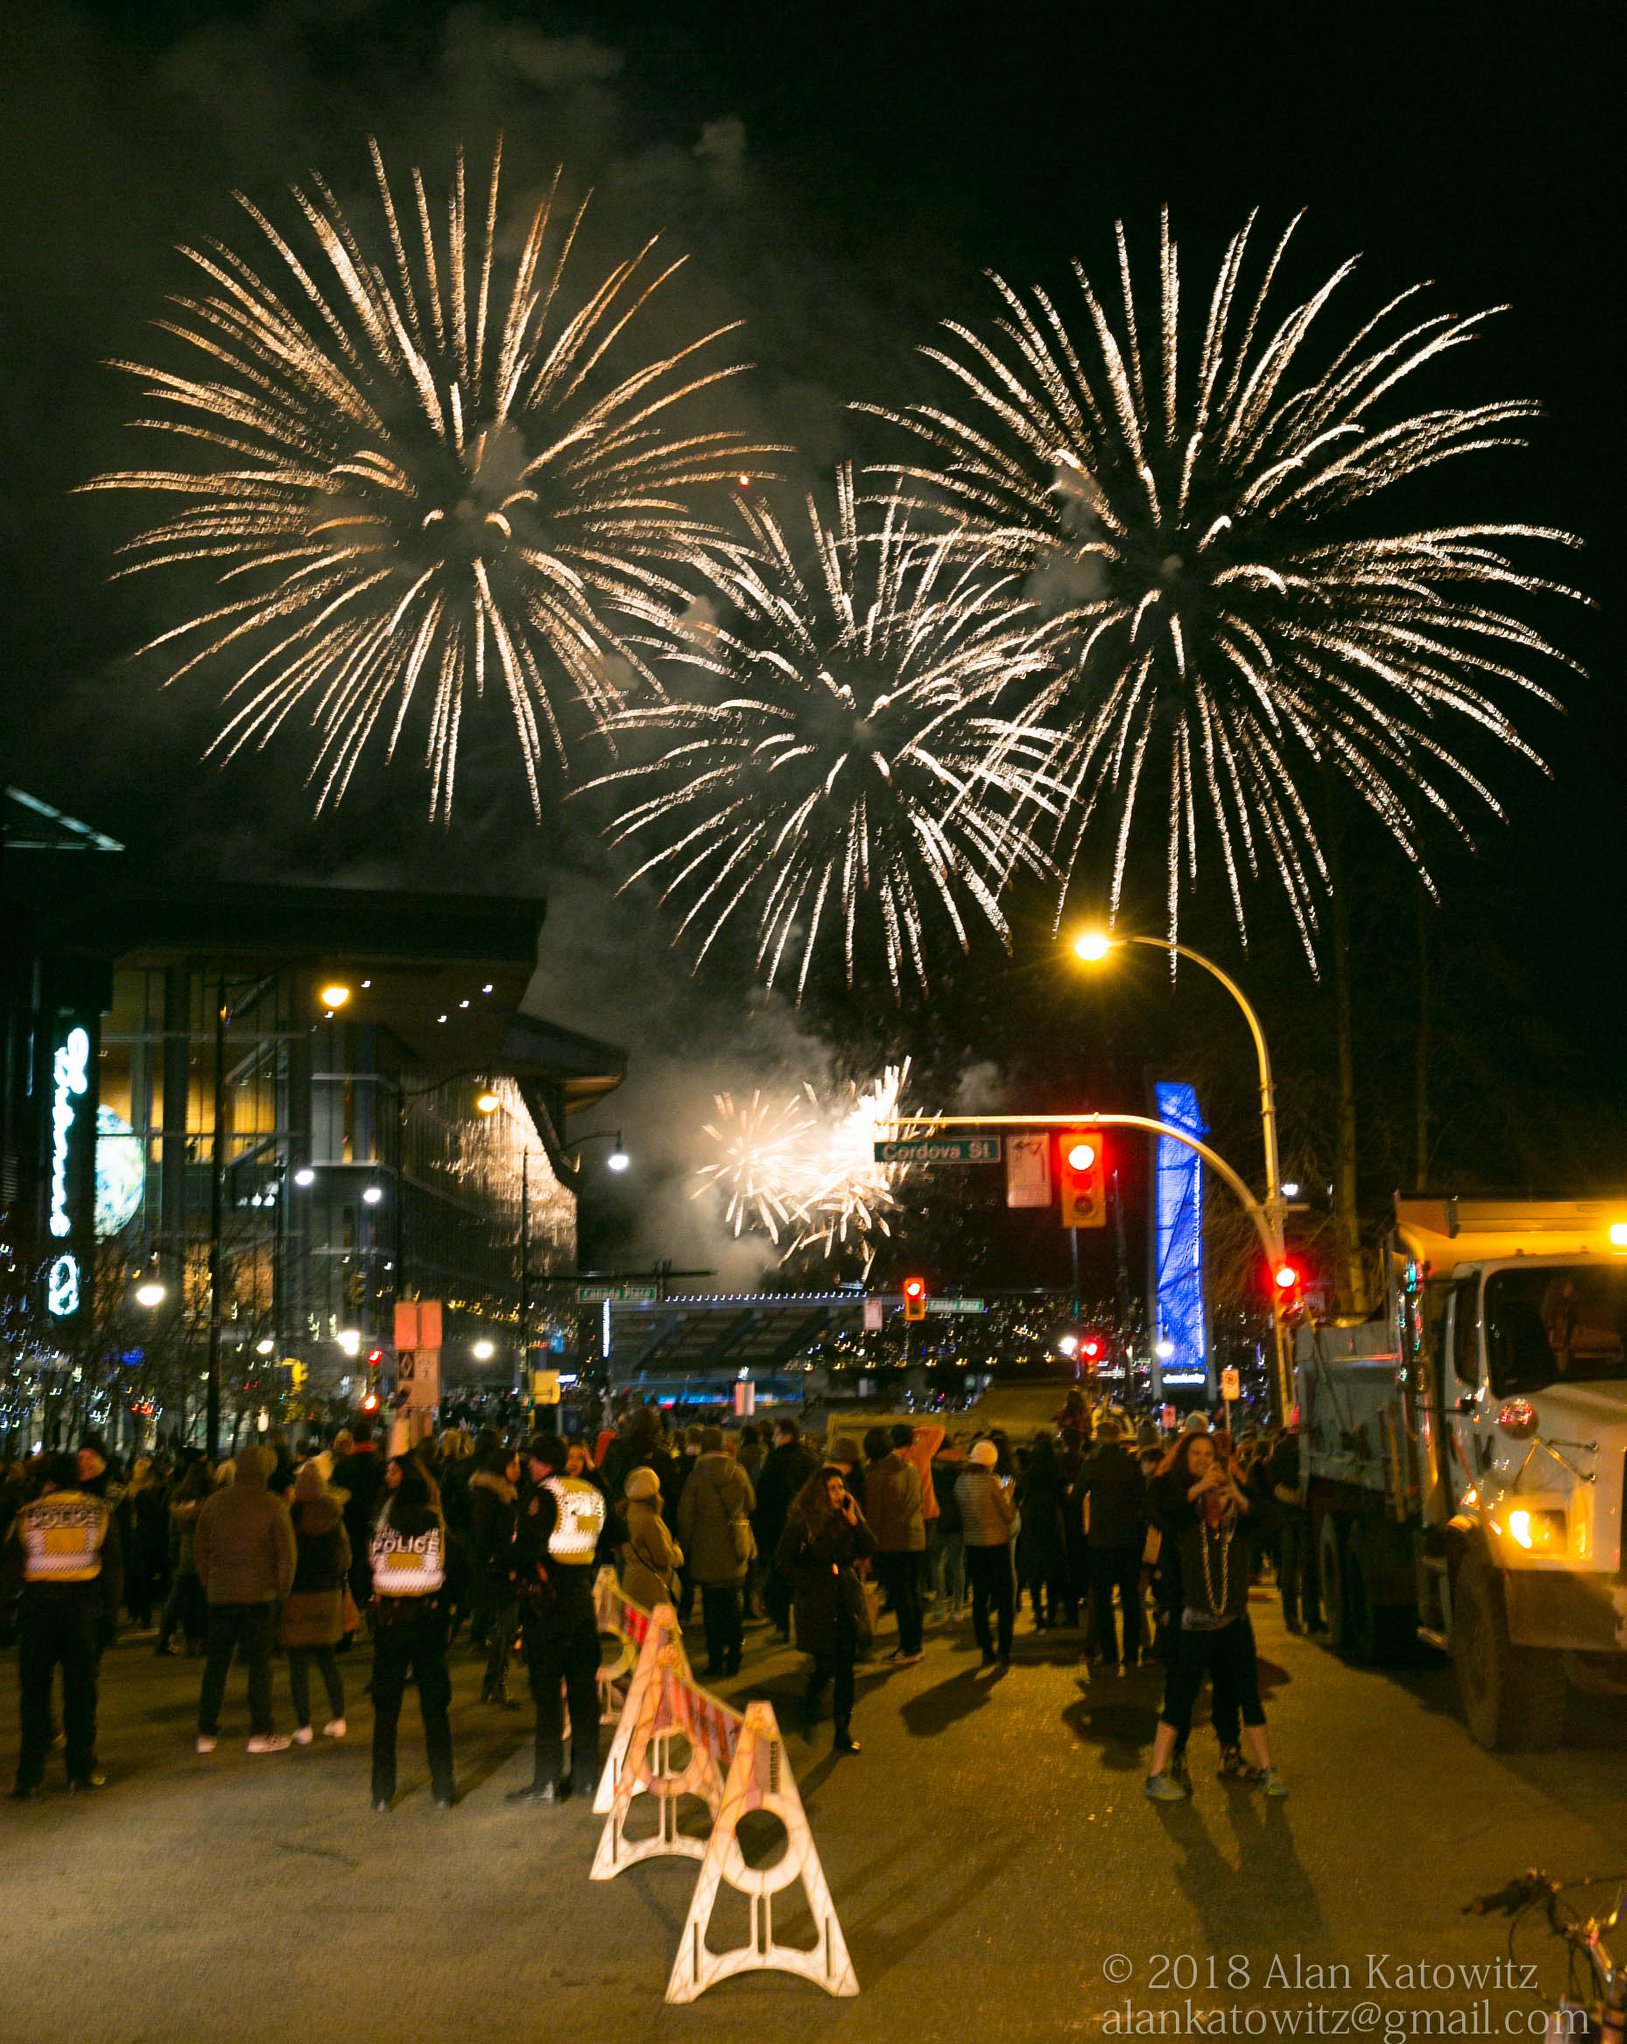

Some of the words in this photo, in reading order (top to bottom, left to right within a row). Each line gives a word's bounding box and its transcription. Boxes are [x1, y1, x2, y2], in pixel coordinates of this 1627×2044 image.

[882, 1142, 961, 1161] Cordova
[967, 1140, 991, 1159] St
[28, 1505, 98, 1529] POLICE
[370, 1535, 441, 1555] POLICE
